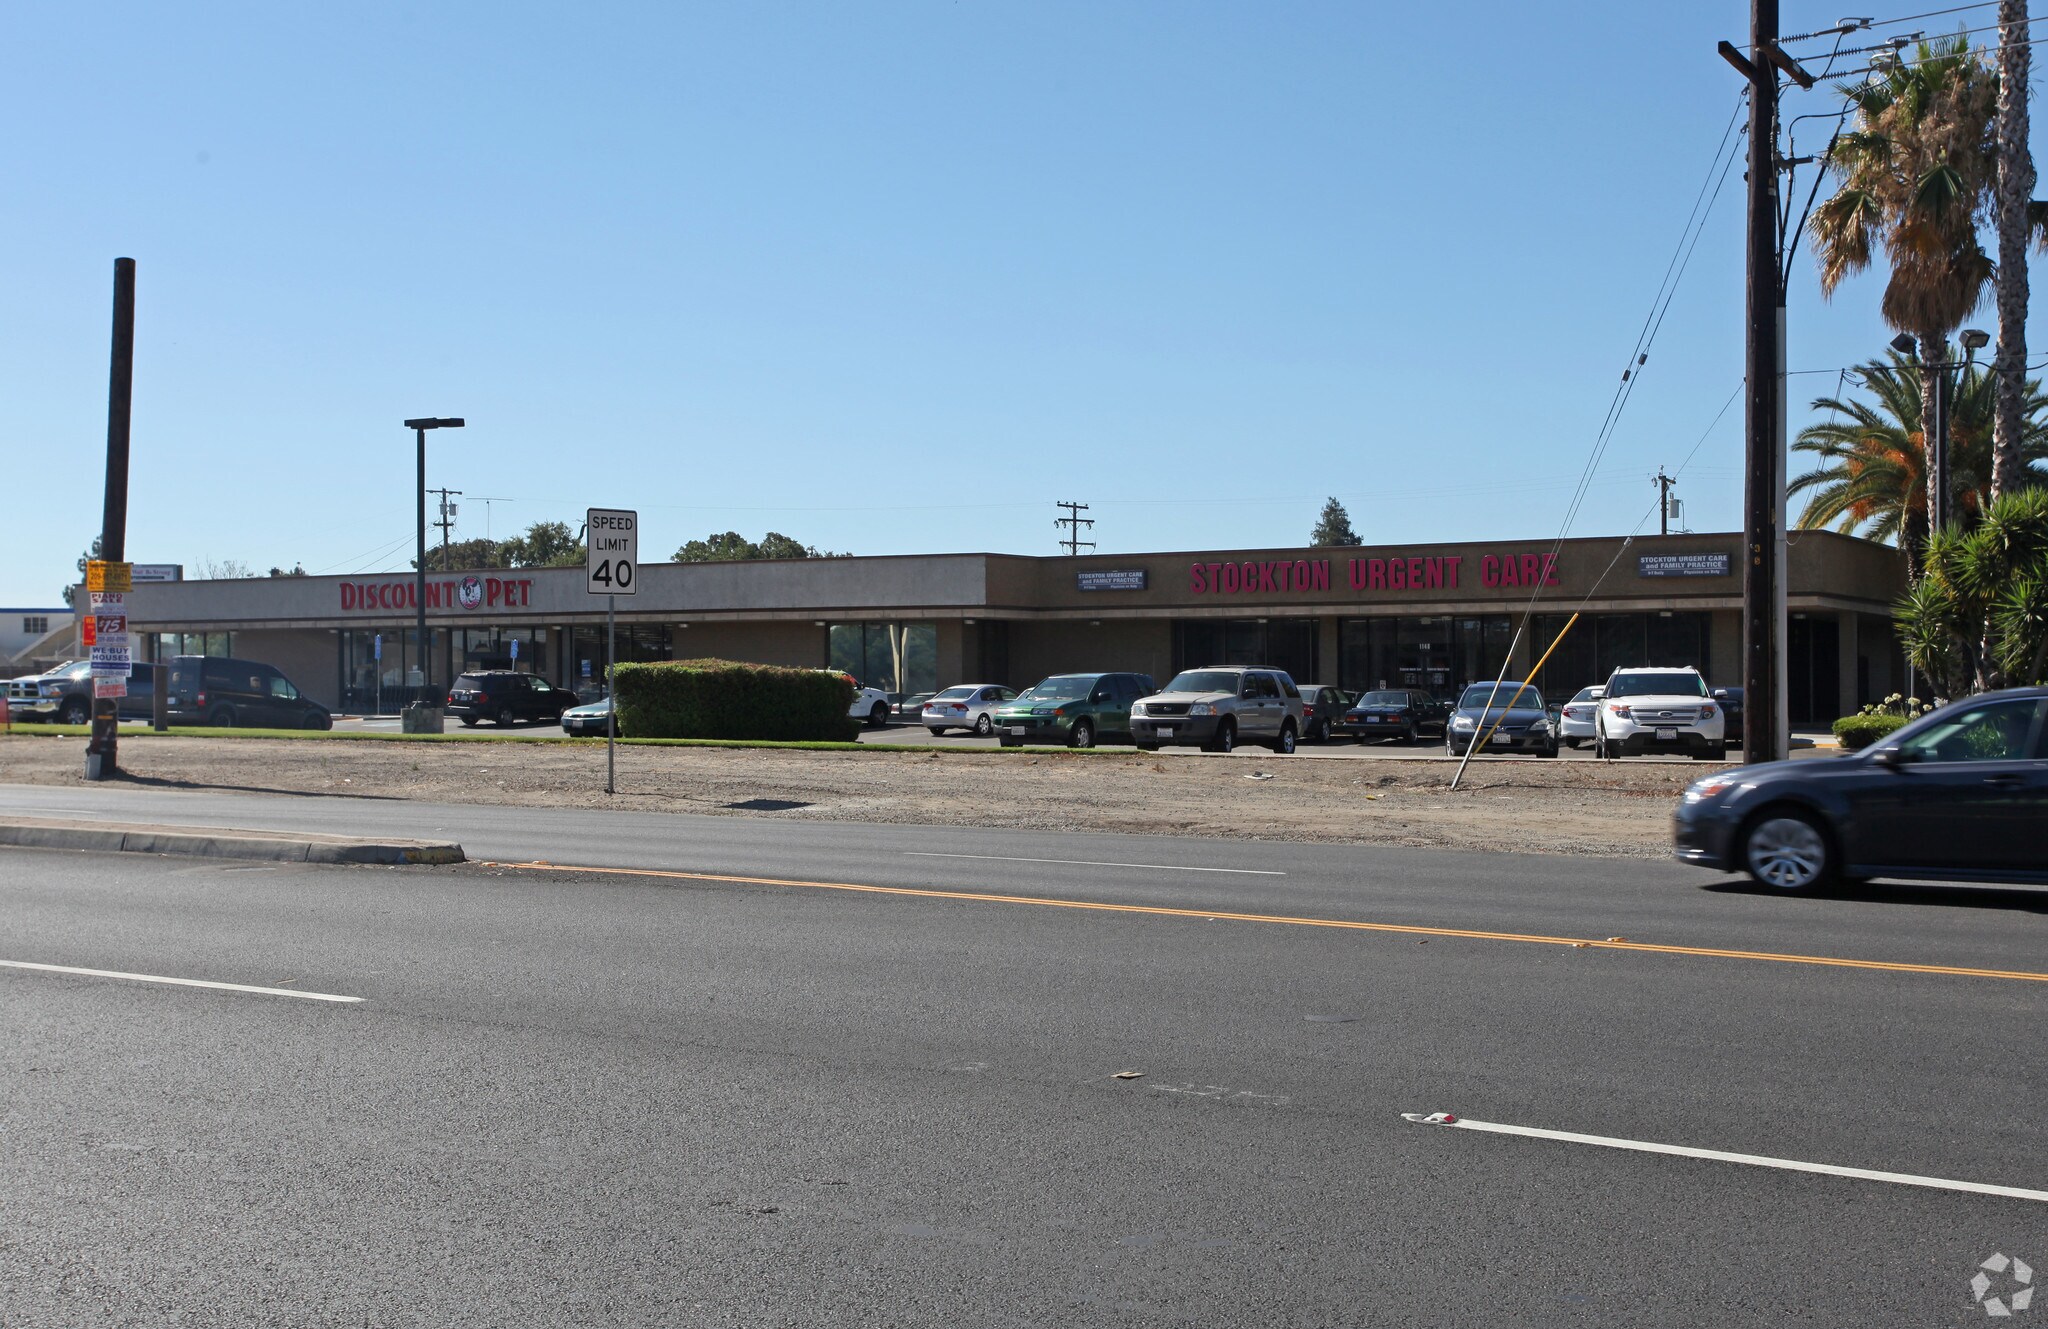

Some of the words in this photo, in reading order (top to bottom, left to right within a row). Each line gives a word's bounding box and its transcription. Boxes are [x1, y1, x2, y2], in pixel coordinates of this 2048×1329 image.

[592, 516, 633, 530] SPEED
[596, 538, 629, 551] LIMIT
[592, 559, 632, 588] 40
[1189, 560, 1330, 593] STOCKTON
[1349, 556, 1462, 590] URGENT
[1480, 553, 1560, 588] CARE
[339, 582, 457, 610] DISCOUNT
[485, 578, 533, 606] PET
[98, 620, 120, 632] $15
